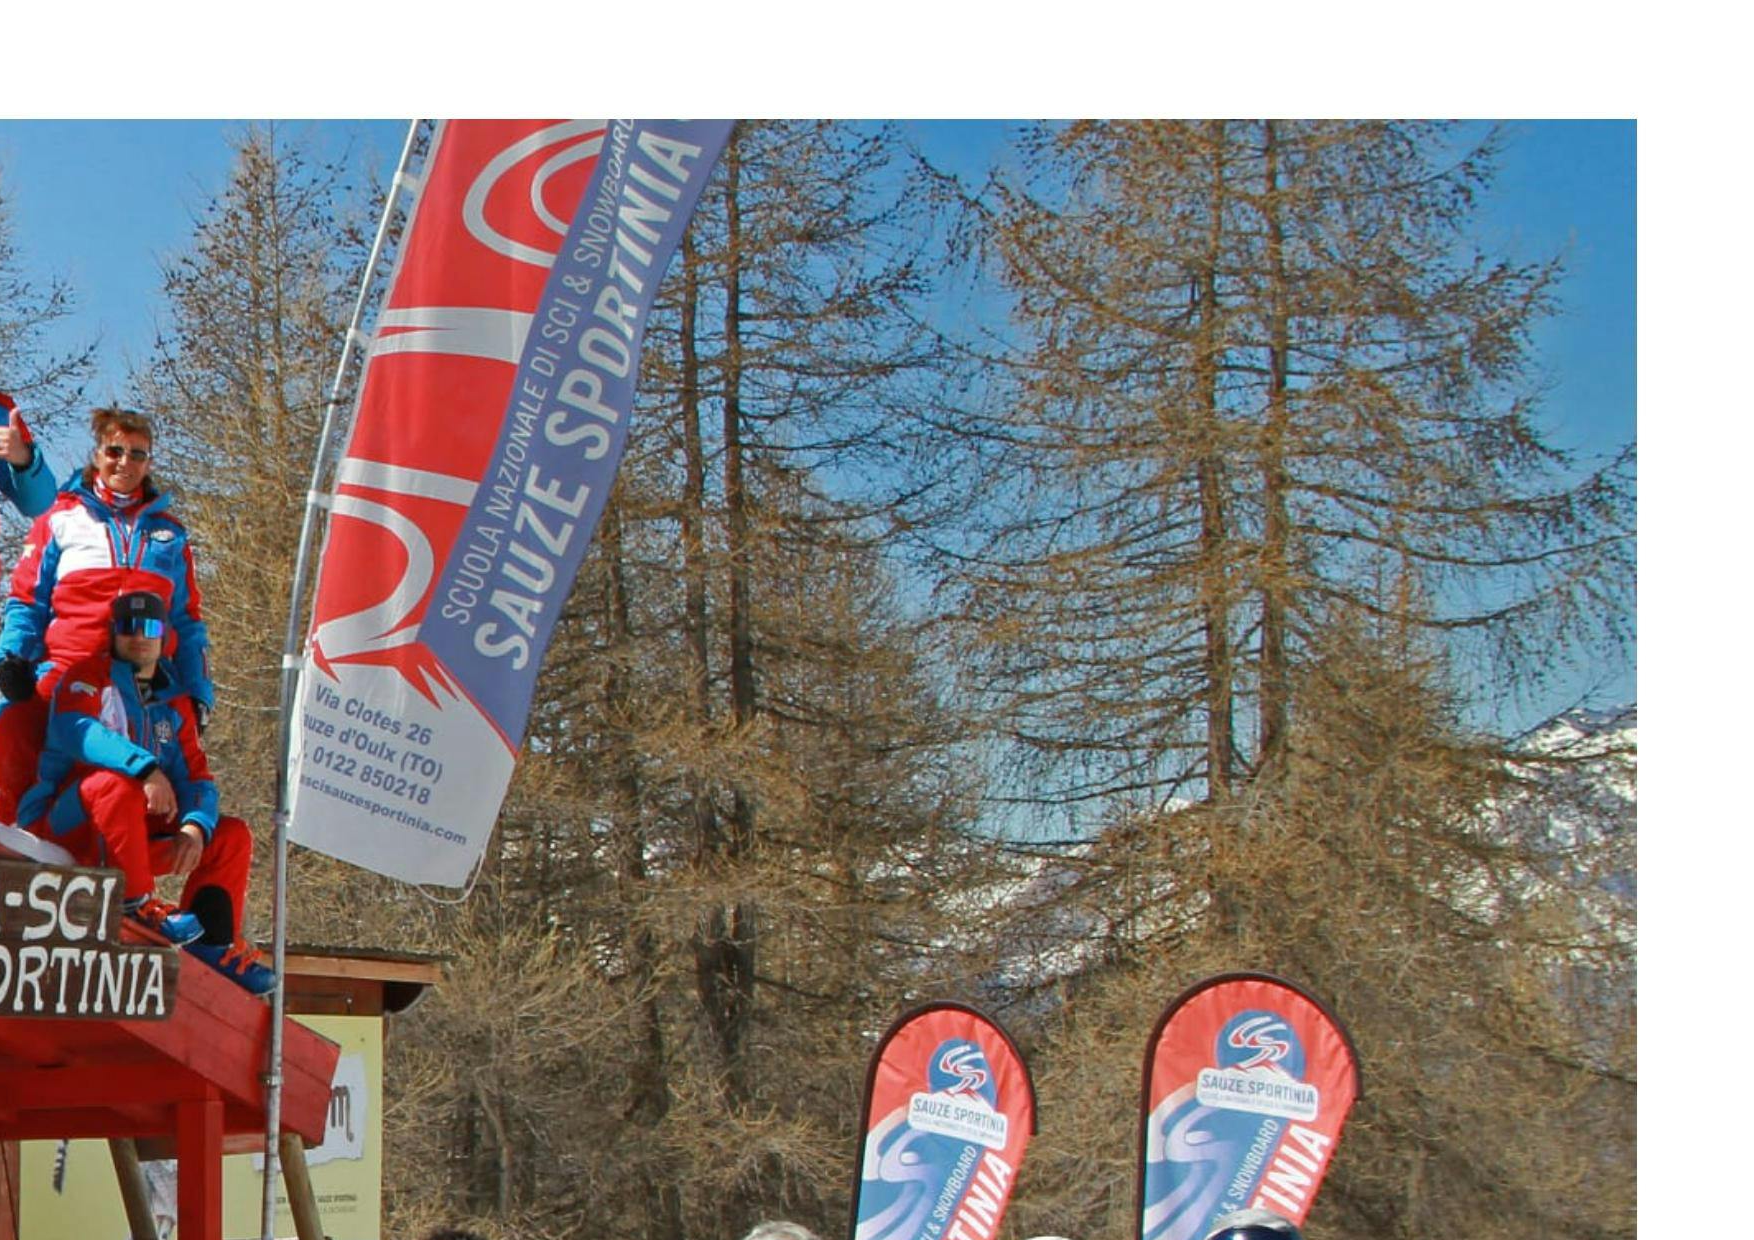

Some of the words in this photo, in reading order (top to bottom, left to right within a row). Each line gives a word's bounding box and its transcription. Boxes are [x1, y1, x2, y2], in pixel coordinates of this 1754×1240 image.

[562, 274, 594, 295] &
[541, 297, 581, 344] SCI
[531, 350, 560, 376] DI
[474, 464, 594, 671] SAUZE
[544, 130, 703, 462] SPORTINIA
[488, 382, 549, 520] NAZIONALE
[442, 523, 506, 625] SCUOLA
[315, 684, 340, 710] Via
[345, 698, 402, 735] Clotes
[406, 723, 433, 746] 26
[313, 746, 357, 777] 0122
[359, 765, 432, 805] 850218
[400, 751, 444, 784] (TO)
[913, 1098, 951, 1120] SAUZE
[1201, 1074, 1244, 1094] SAUZE
[1247, 1080, 1315, 1105] SPORTINIA
[932, 1145, 978, 1222] SNOWBOARD
[1228, 1119, 1279, 1200] SNOWBOARD
[926, 1221, 941, 1236] &
